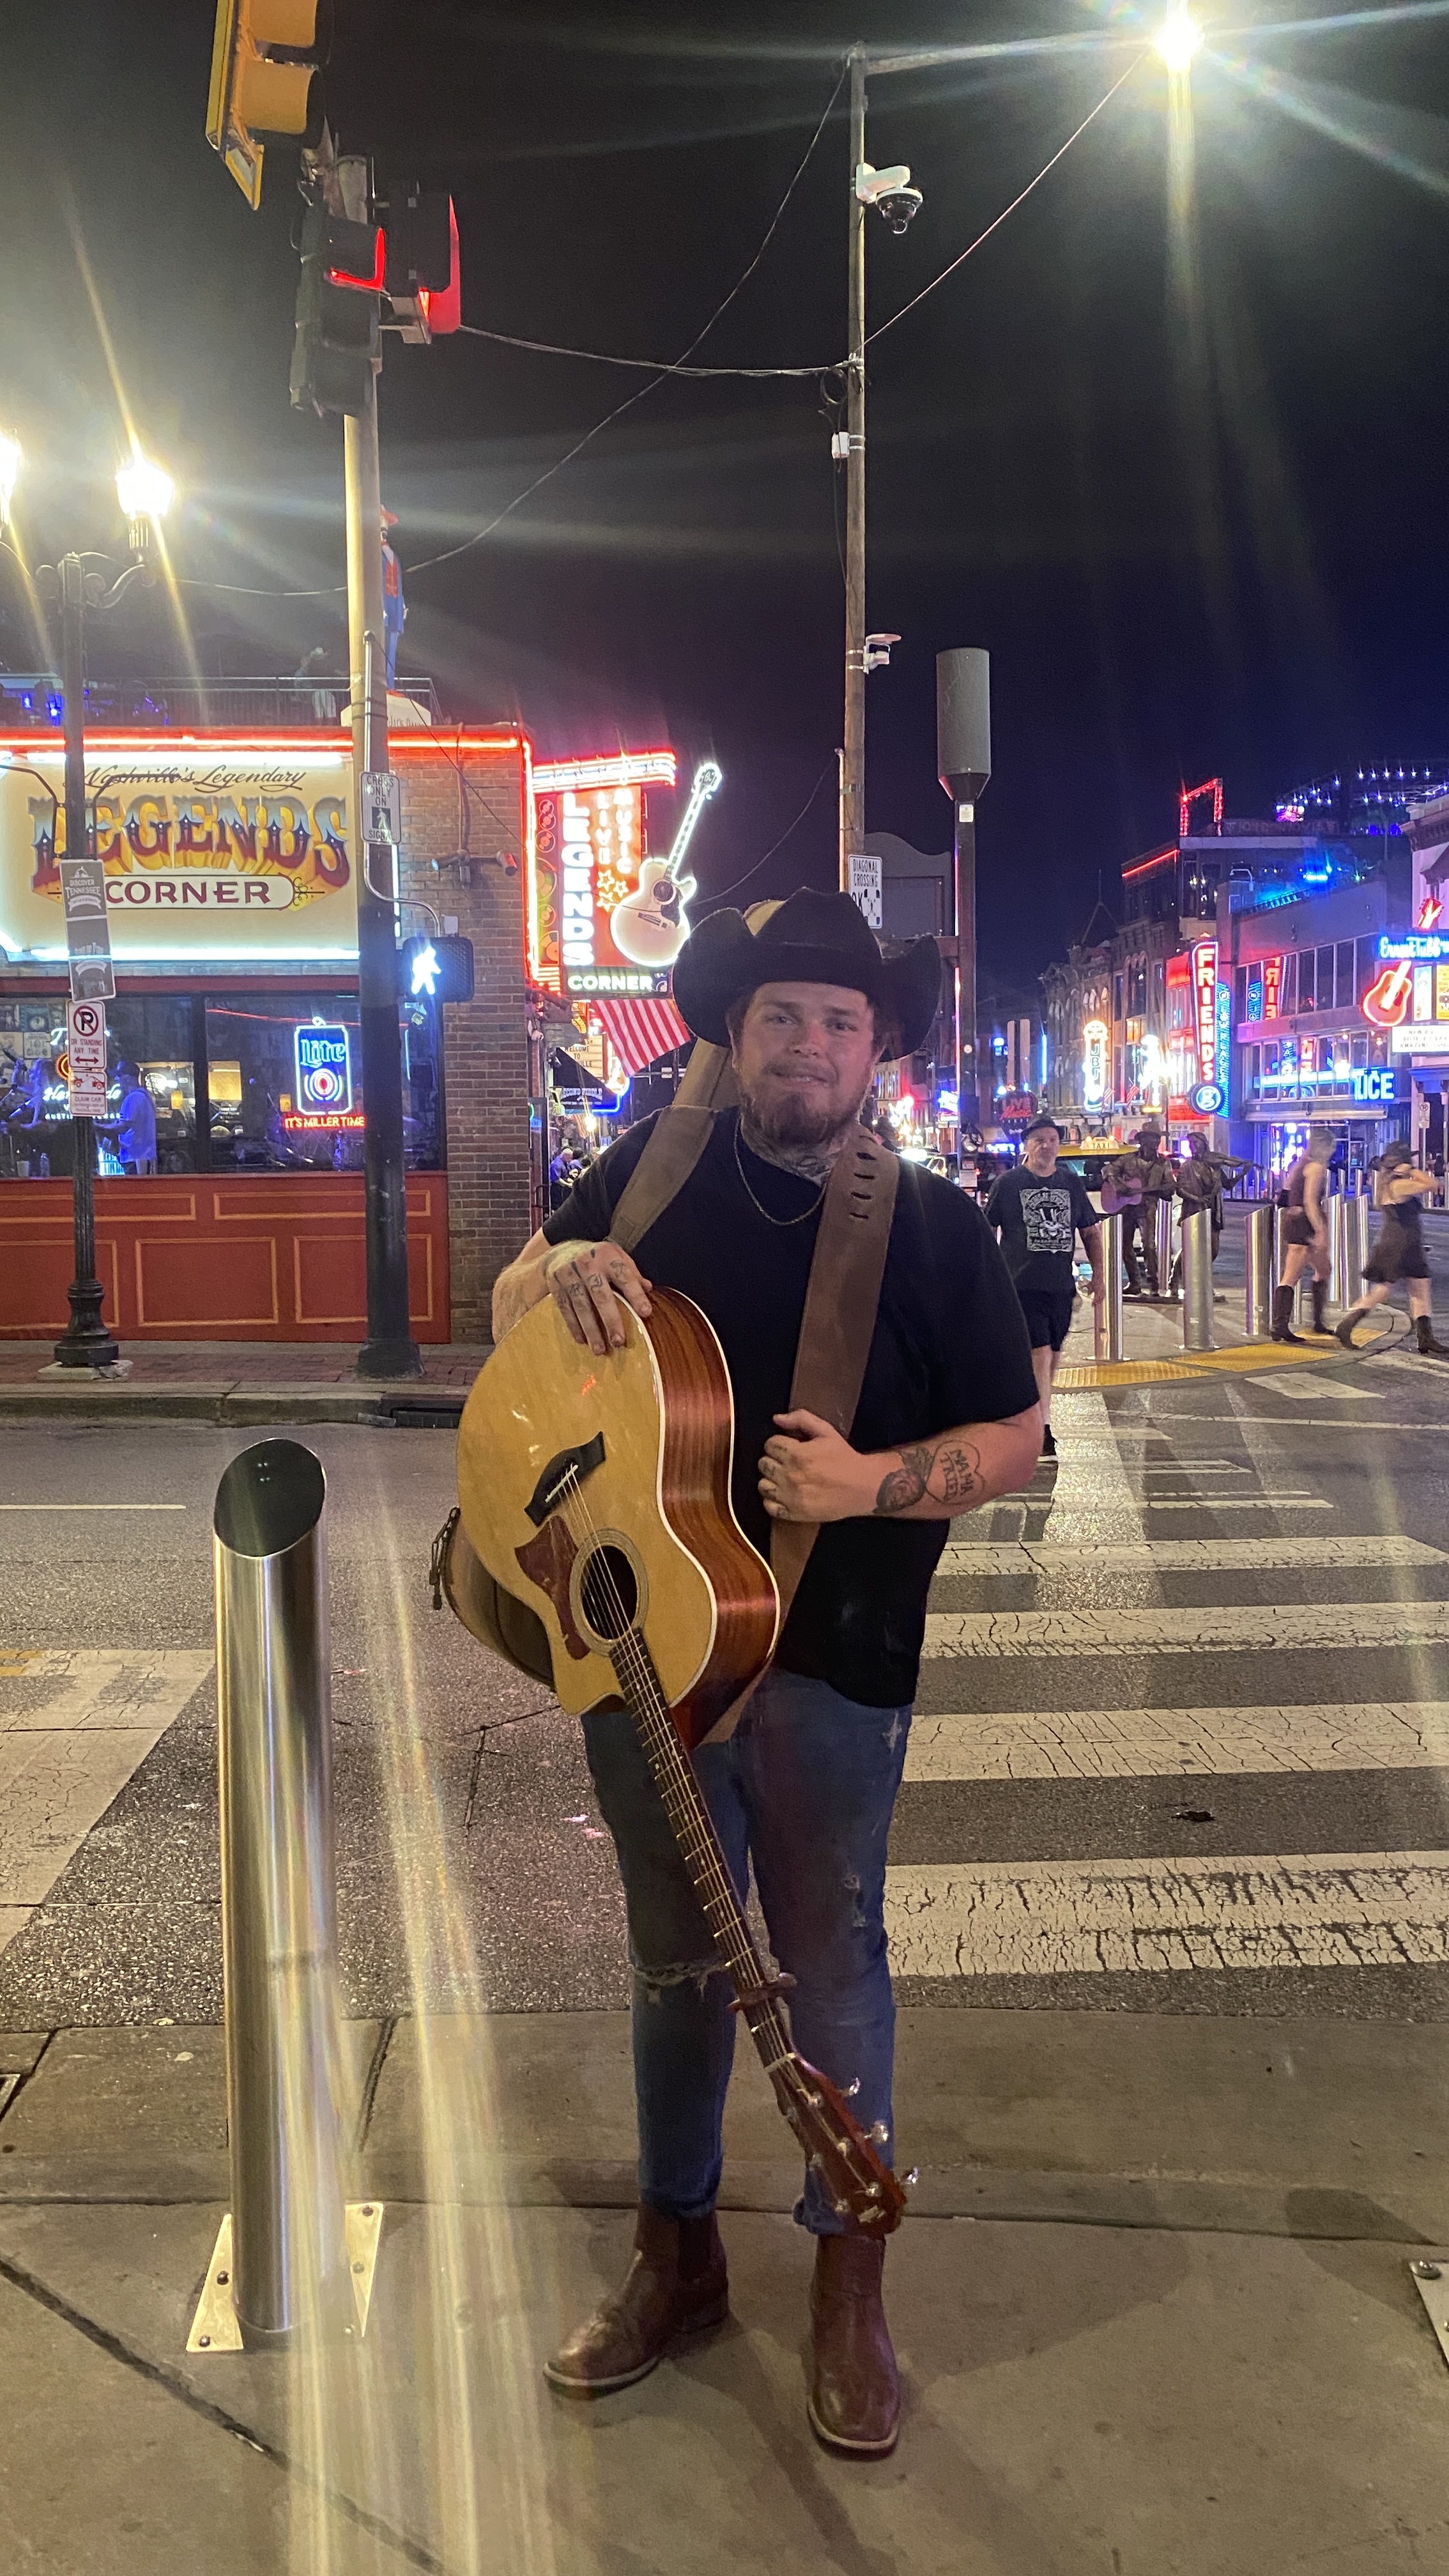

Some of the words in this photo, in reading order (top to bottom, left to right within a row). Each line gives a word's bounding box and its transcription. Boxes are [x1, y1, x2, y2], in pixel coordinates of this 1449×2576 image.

[194, 764, 308, 793] Legendary
[367, 775, 394, 788] CROSS
[369, 786, 392, 798] ONLY
[374, 797, 387, 807] ON
[595, 791, 611, 865] LIVE
[613, 788, 633, 875] MUSIC
[27, 794, 350, 893] LEGENDS
[853, 859, 878, 873] DIAGONAL
[70, 878, 95, 887] DISCOVER
[562, 791, 595, 967] LEGENDS
[854, 873, 878, 887] CROSSING
[65, 886, 102, 899] TENNESSEE
[105, 880, 271, 904] CORNER
[567, 974, 653, 992] CORNER
[1198, 949, 1215, 1081] FRIENDS
[285, 1116, 302, 1129] IT'S
[303, 1117, 340, 1128] MILLER
[341, 1116, 365, 1127] TIME
[940, 1452, 958, 1501] TRIED
